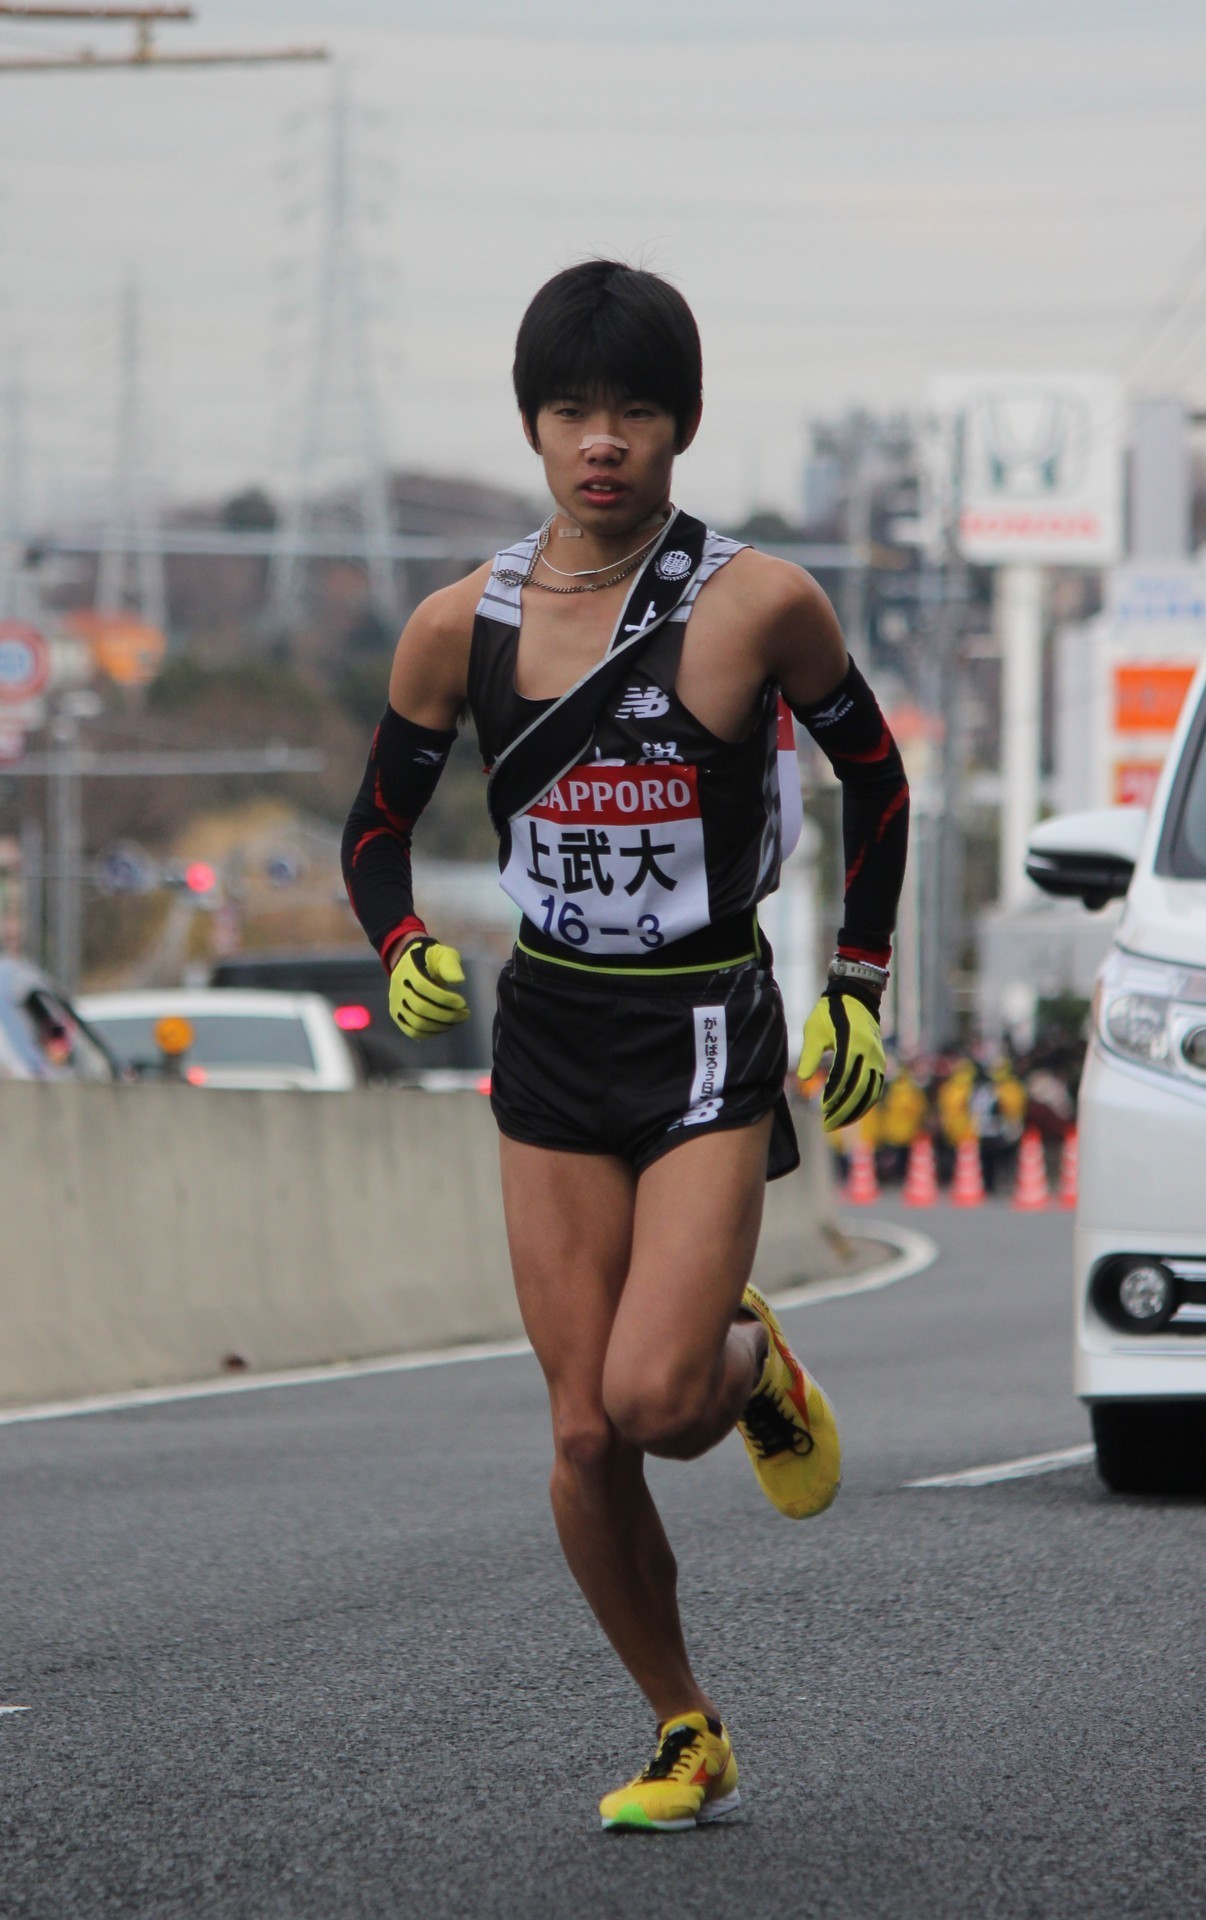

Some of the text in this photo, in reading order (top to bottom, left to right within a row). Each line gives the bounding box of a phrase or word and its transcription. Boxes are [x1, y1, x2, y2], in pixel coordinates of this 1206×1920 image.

[526, 821, 678, 897] 上武大
[699, 1017, 718, 1099] がんばろう日
